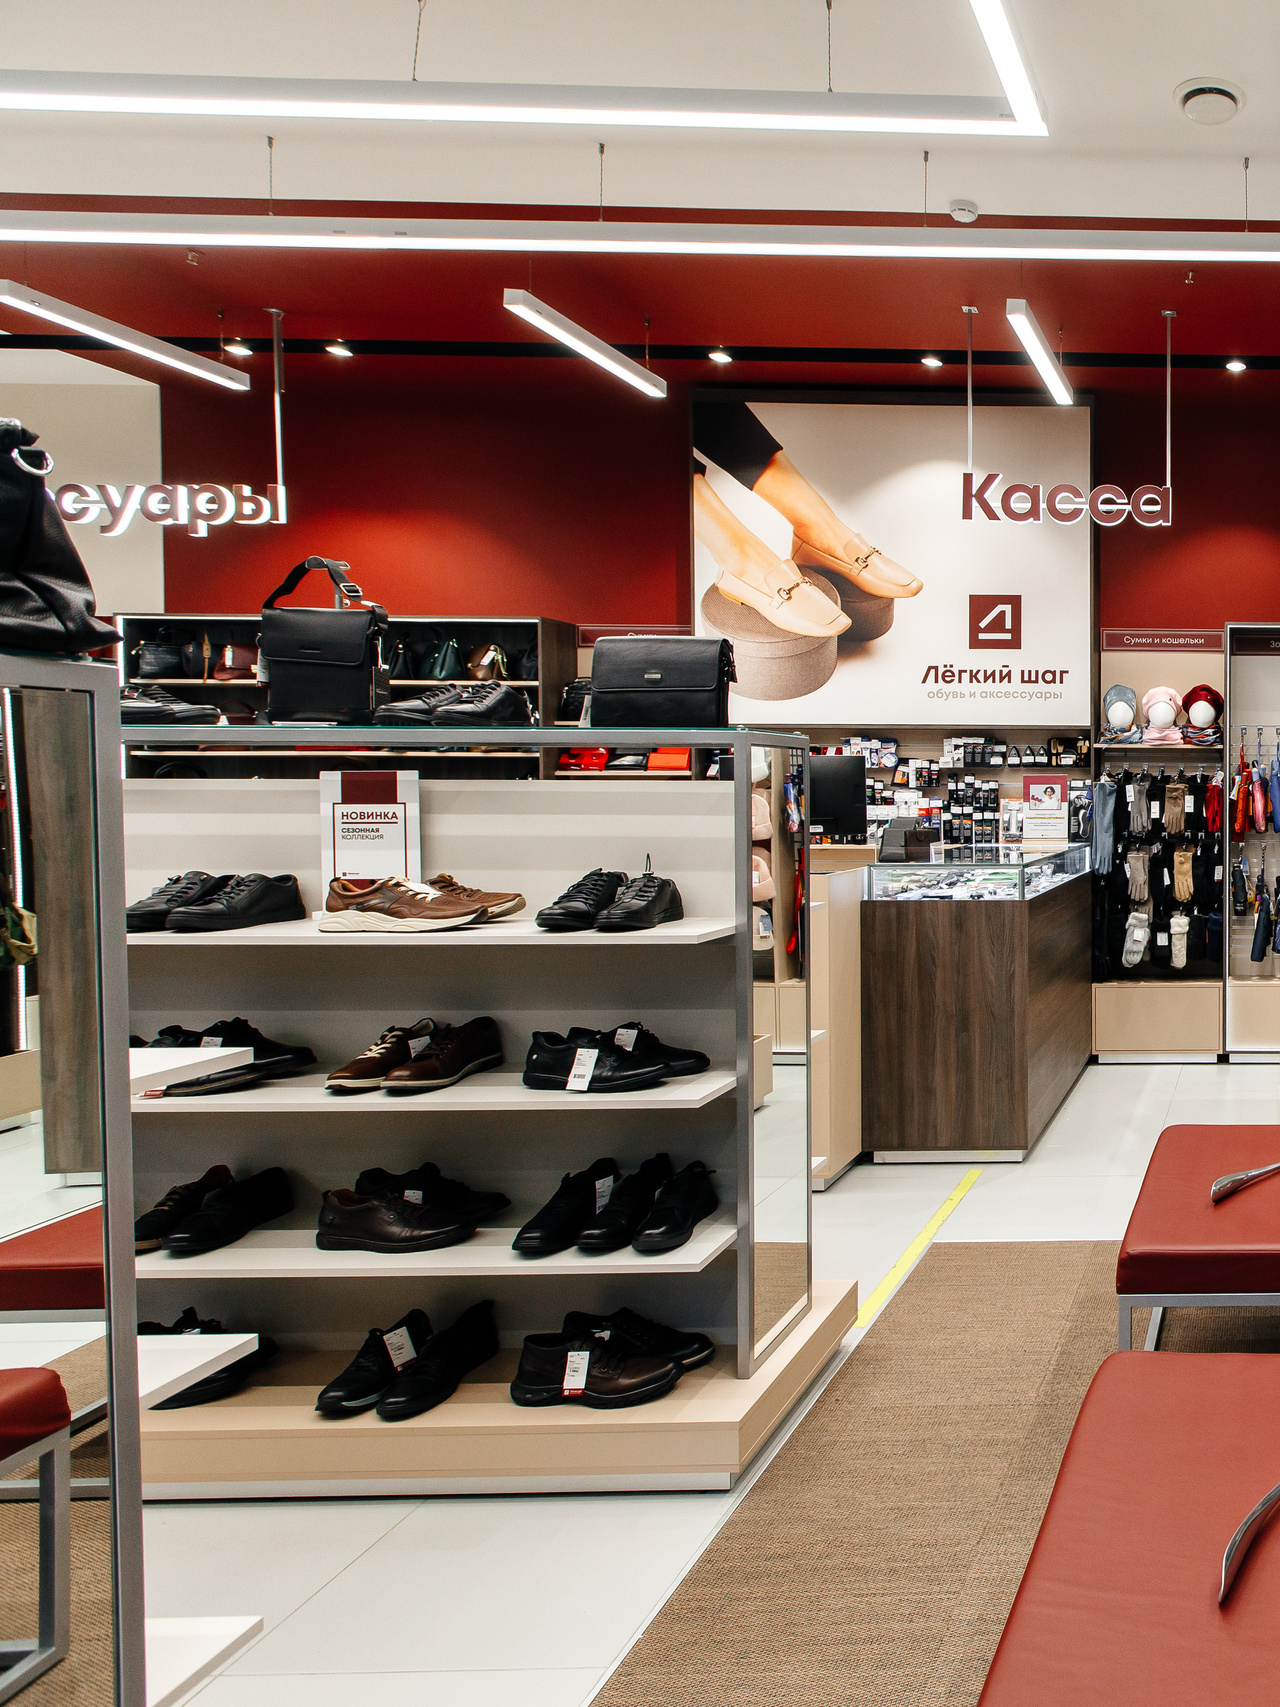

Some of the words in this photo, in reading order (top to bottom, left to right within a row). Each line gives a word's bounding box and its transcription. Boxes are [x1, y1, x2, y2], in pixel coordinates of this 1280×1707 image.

[961, 472, 1172, 527] Касса
[46, 483, 288, 537] суары
[1123, 636, 1153, 645] Сумки
[921, 664, 1012, 684] Лёгкий
[1020, 669, 1070, 685] шаг
[927, 688, 966, 701] обувь
[968, 690, 977, 699] и
[979, 690, 1064, 702] аксессуары
[341, 811, 399, 820] НОВИНКА
